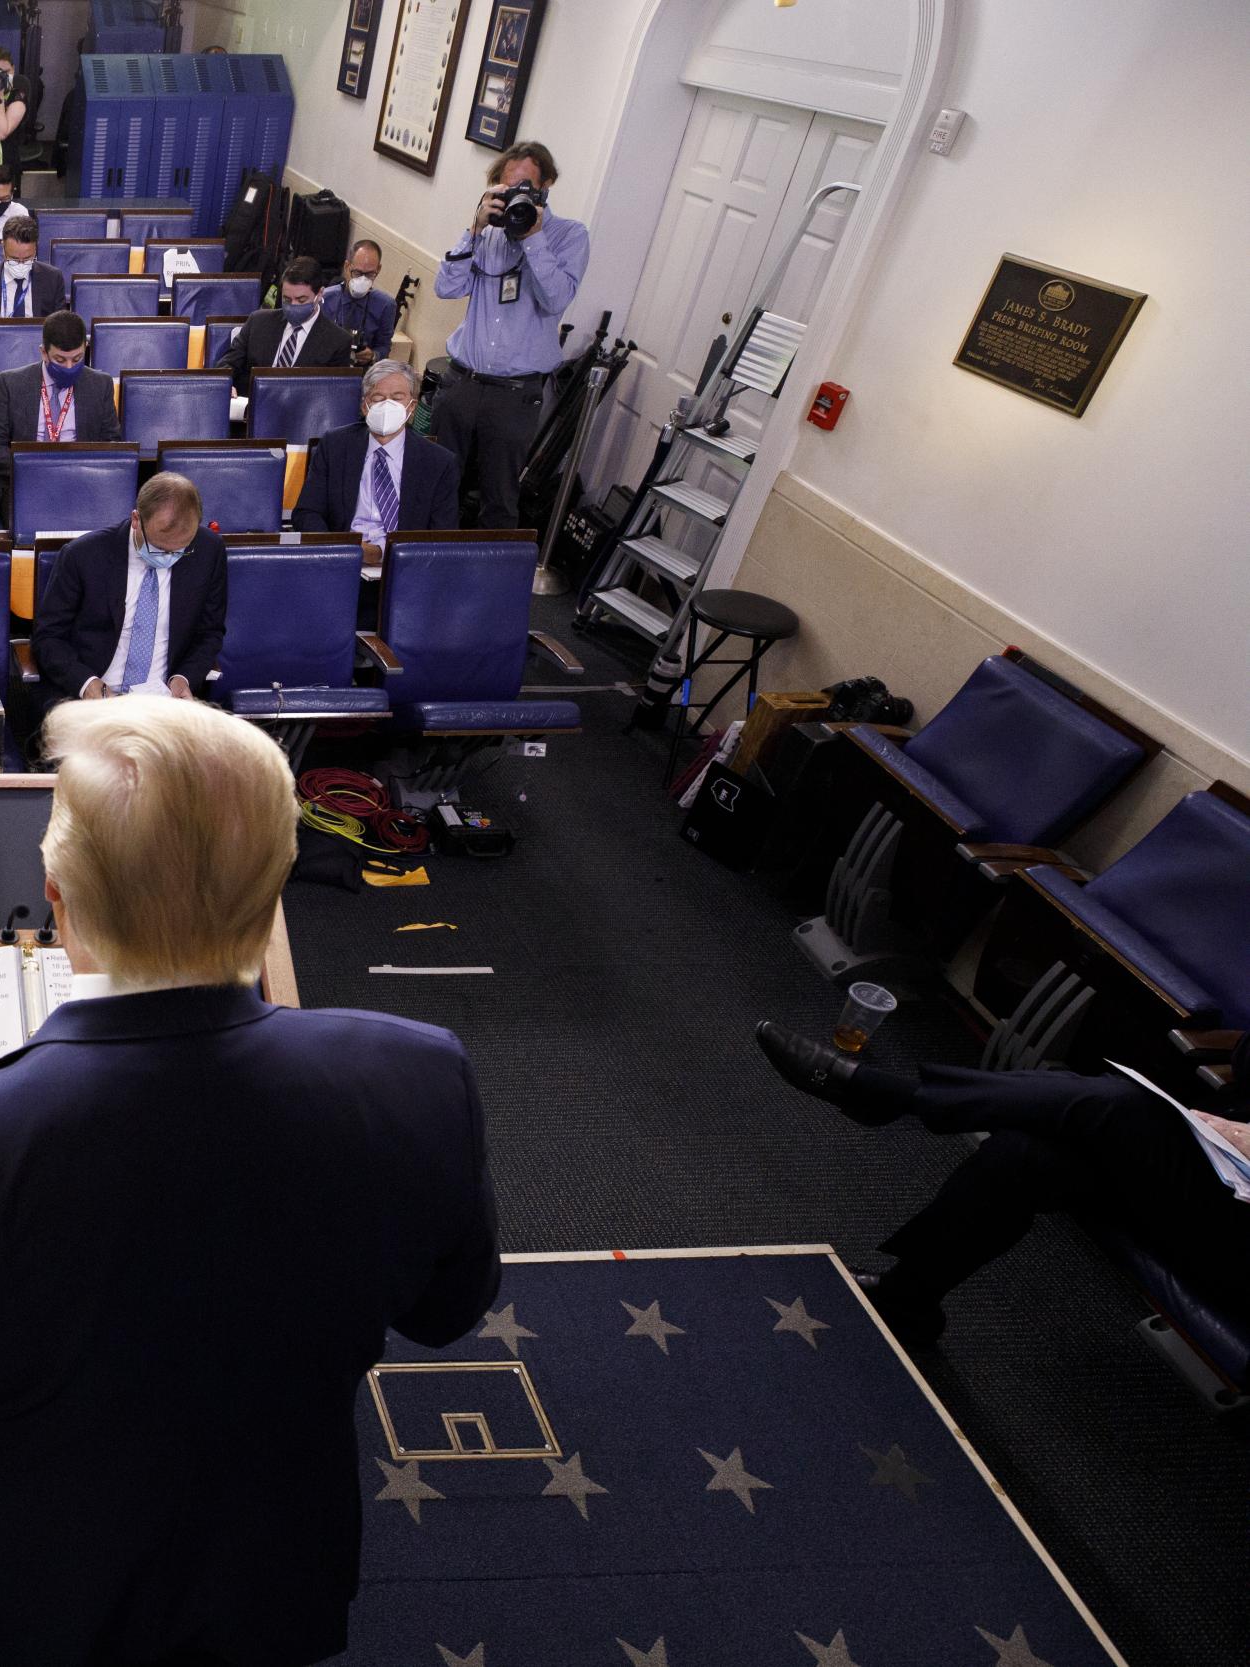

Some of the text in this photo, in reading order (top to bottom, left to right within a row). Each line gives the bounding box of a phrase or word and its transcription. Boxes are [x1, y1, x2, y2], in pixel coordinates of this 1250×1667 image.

[991, 311, 1091, 354] PRESS BRIEFING ROOM
[1001, 299, 1036, 319] JAMES
[1038, 310, 1048, 324] S.
[1051, 316, 1092, 338] BRADY
